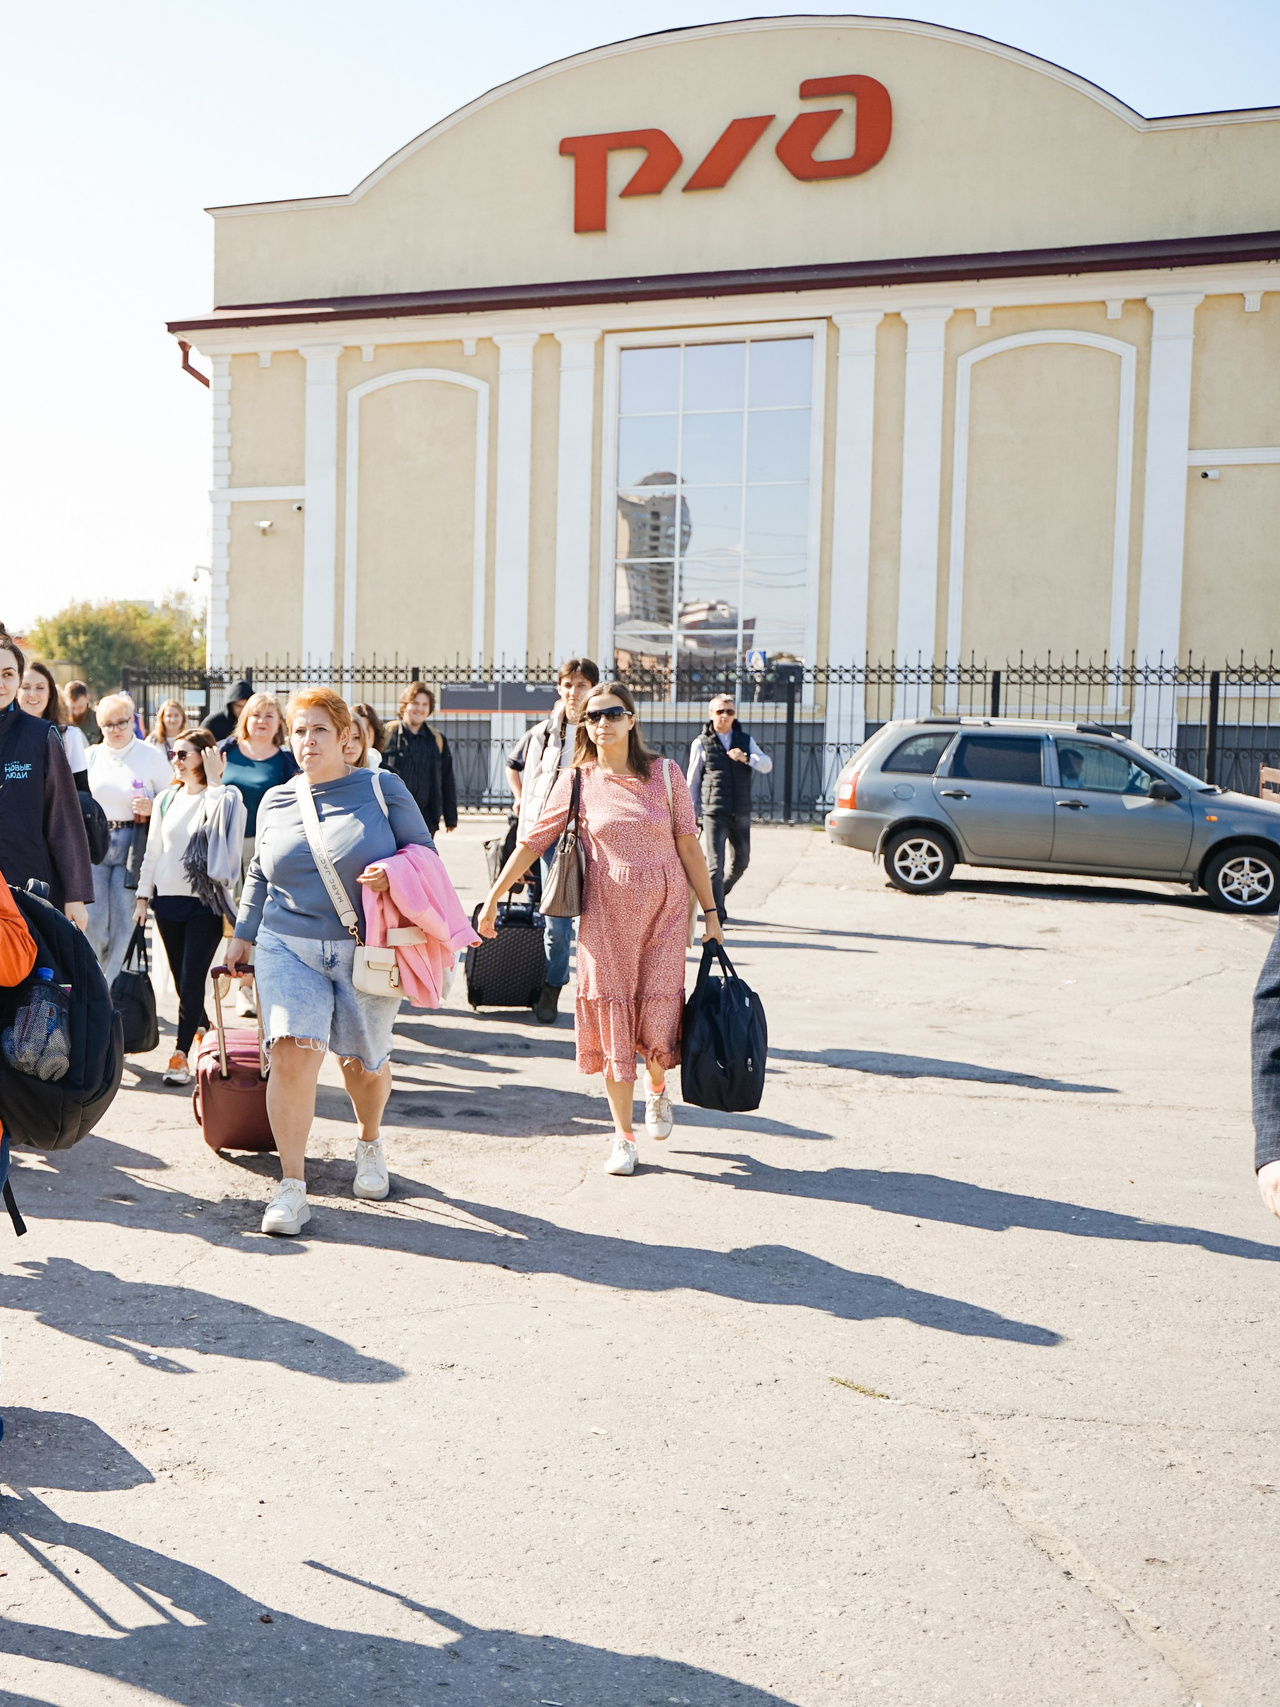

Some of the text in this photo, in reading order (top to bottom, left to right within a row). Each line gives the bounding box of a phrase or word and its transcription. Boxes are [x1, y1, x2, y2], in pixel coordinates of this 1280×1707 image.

[4, 763, 32, 773] НОВЫЕ
[5, 771, 28, 780] ЛЮДИ
[329, 878, 344, 903] MARC
